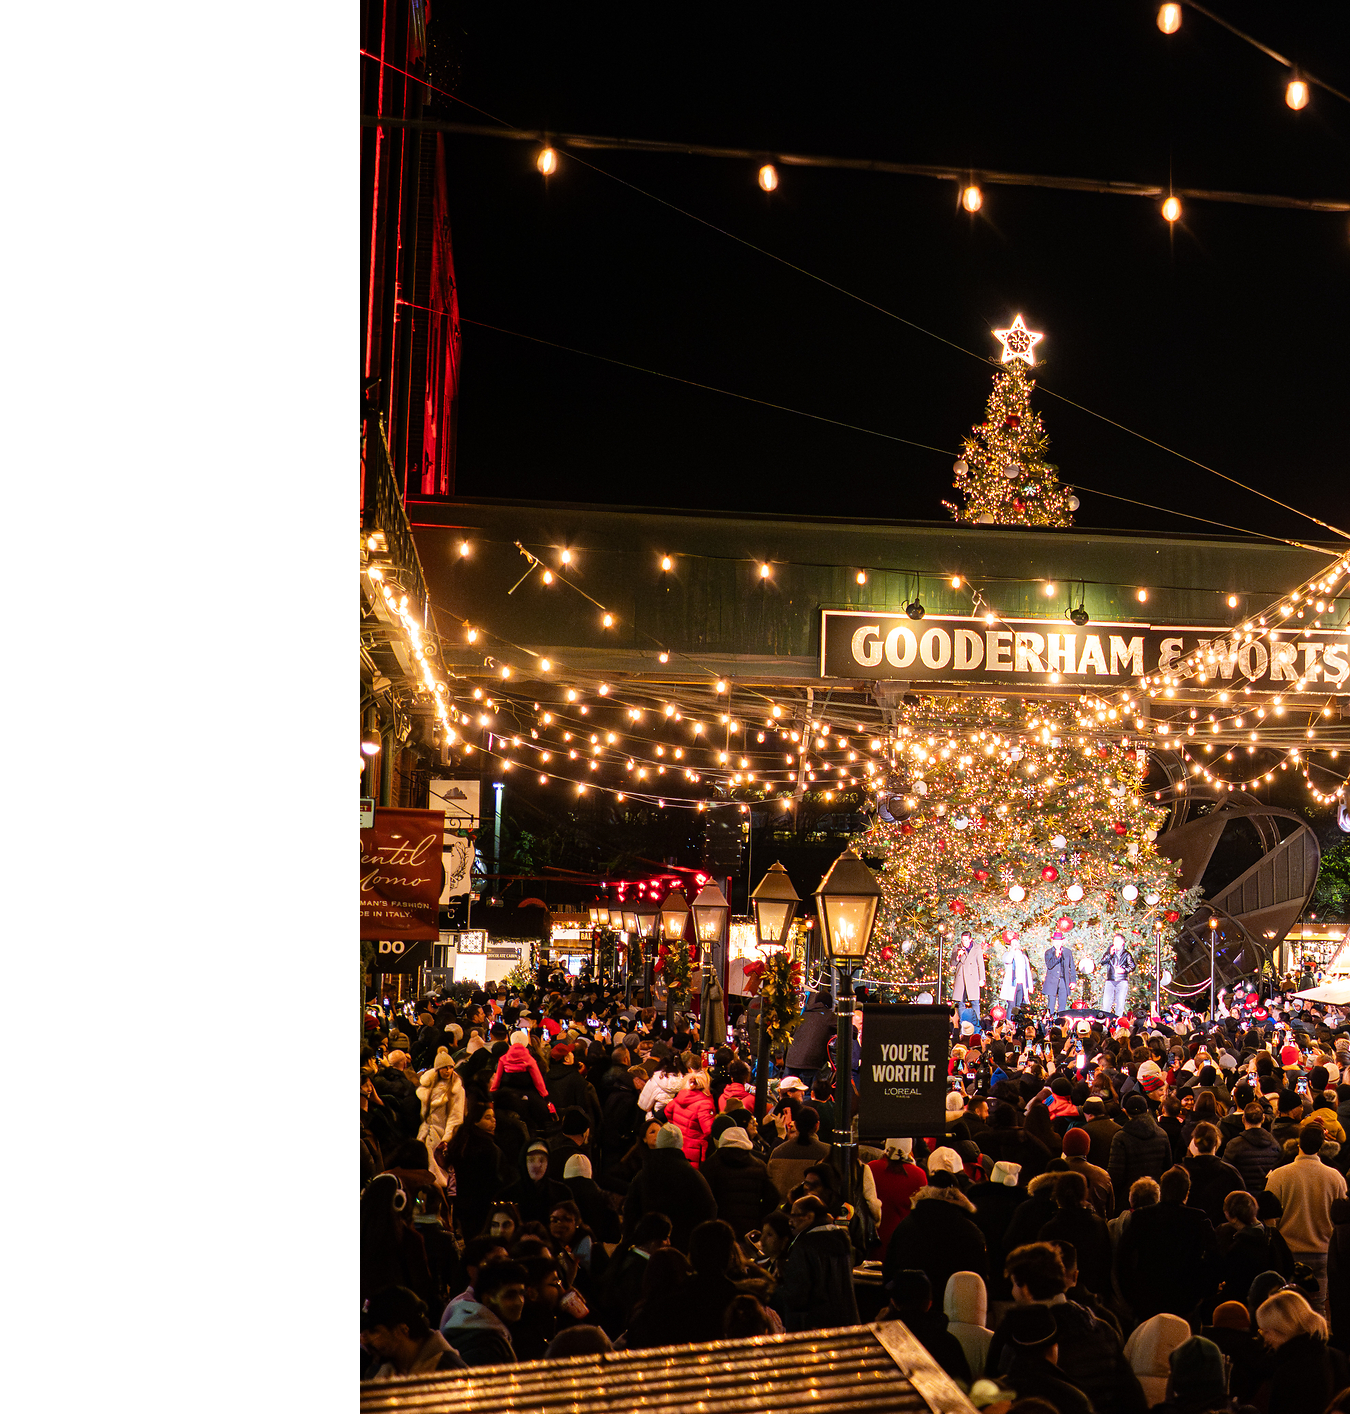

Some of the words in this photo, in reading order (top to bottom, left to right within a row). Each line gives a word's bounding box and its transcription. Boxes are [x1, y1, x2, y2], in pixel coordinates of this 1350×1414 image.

[851, 625, 1145, 676] GOODERHAM
[1158, 637, 1193, 678] &
[1197, 638, 1349, 684] WORTS
[360, 834, 437, 867] entil
[391, 901, 432, 910] FASHION.
[881, 1044, 930, 1062] YOU'RE
[872, 1064, 920, 1083] WORTH
[924, 1064, 936, 1083] IT
